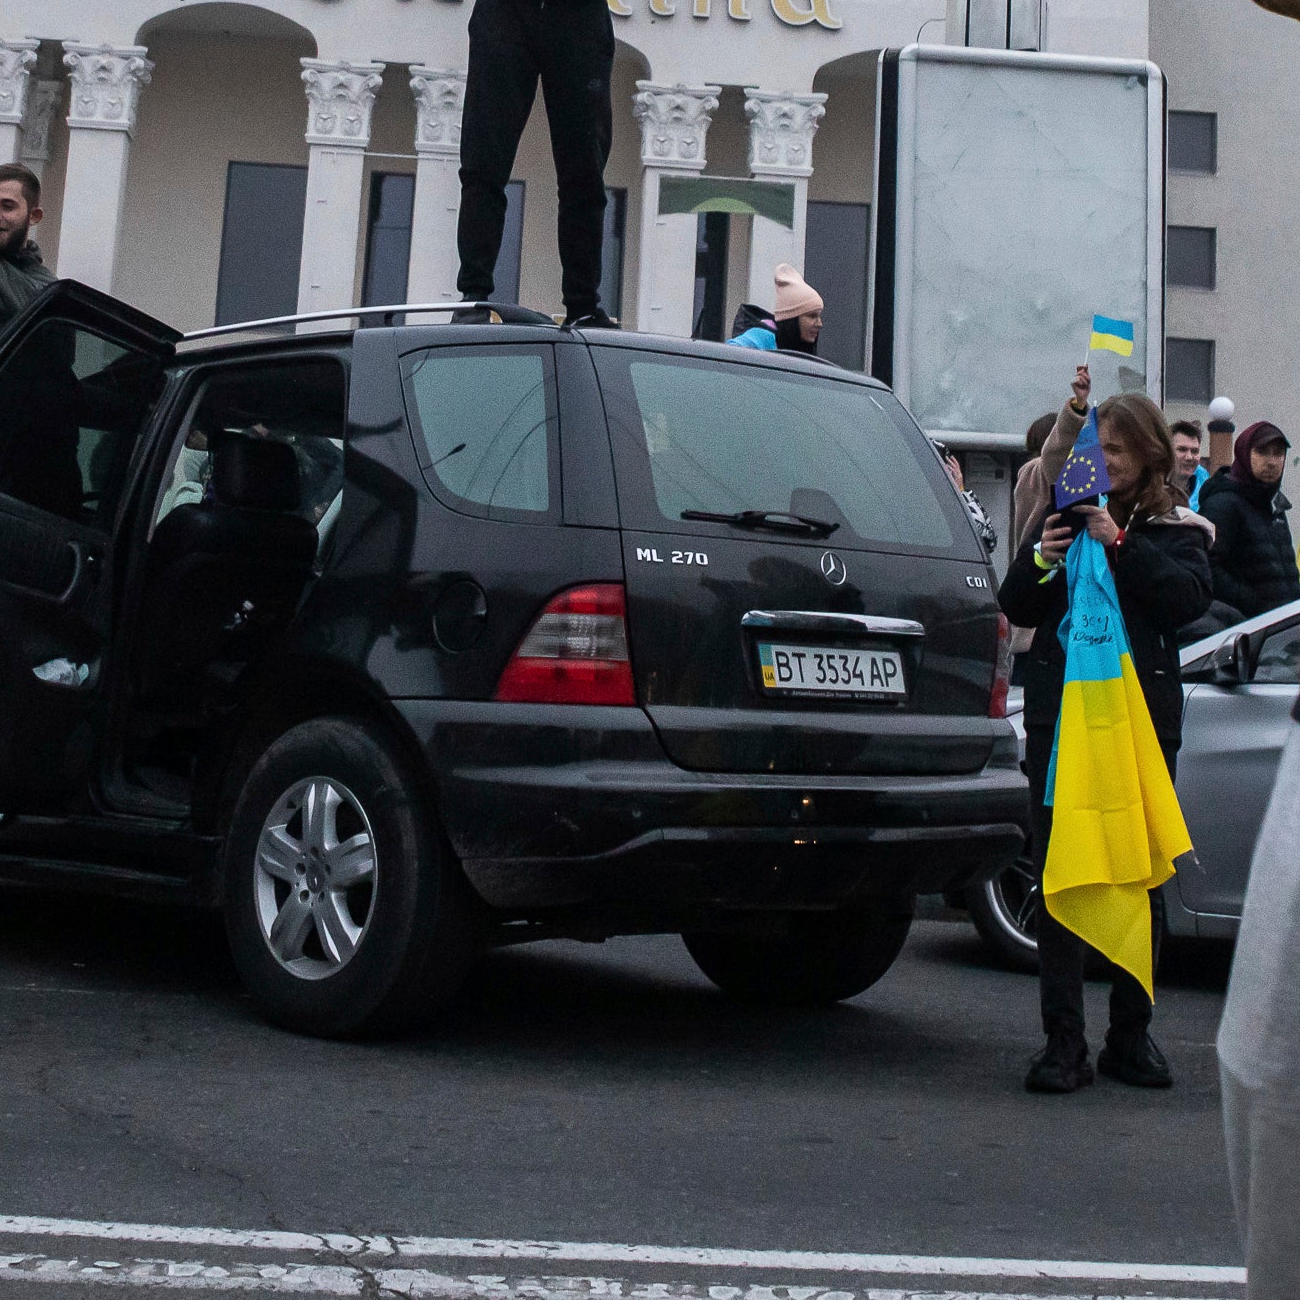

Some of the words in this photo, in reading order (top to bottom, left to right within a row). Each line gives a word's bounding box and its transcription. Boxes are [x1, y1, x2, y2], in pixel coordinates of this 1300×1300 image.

[636, 547, 664, 563] ML
[671, 550, 709, 566] 270
[966, 575, 988, 589] CDI
[764, 670, 775, 682] UA
[775, 650, 806, 683] BT
[813, 653, 865, 686] 3534
[870, 657, 898, 688] AP
